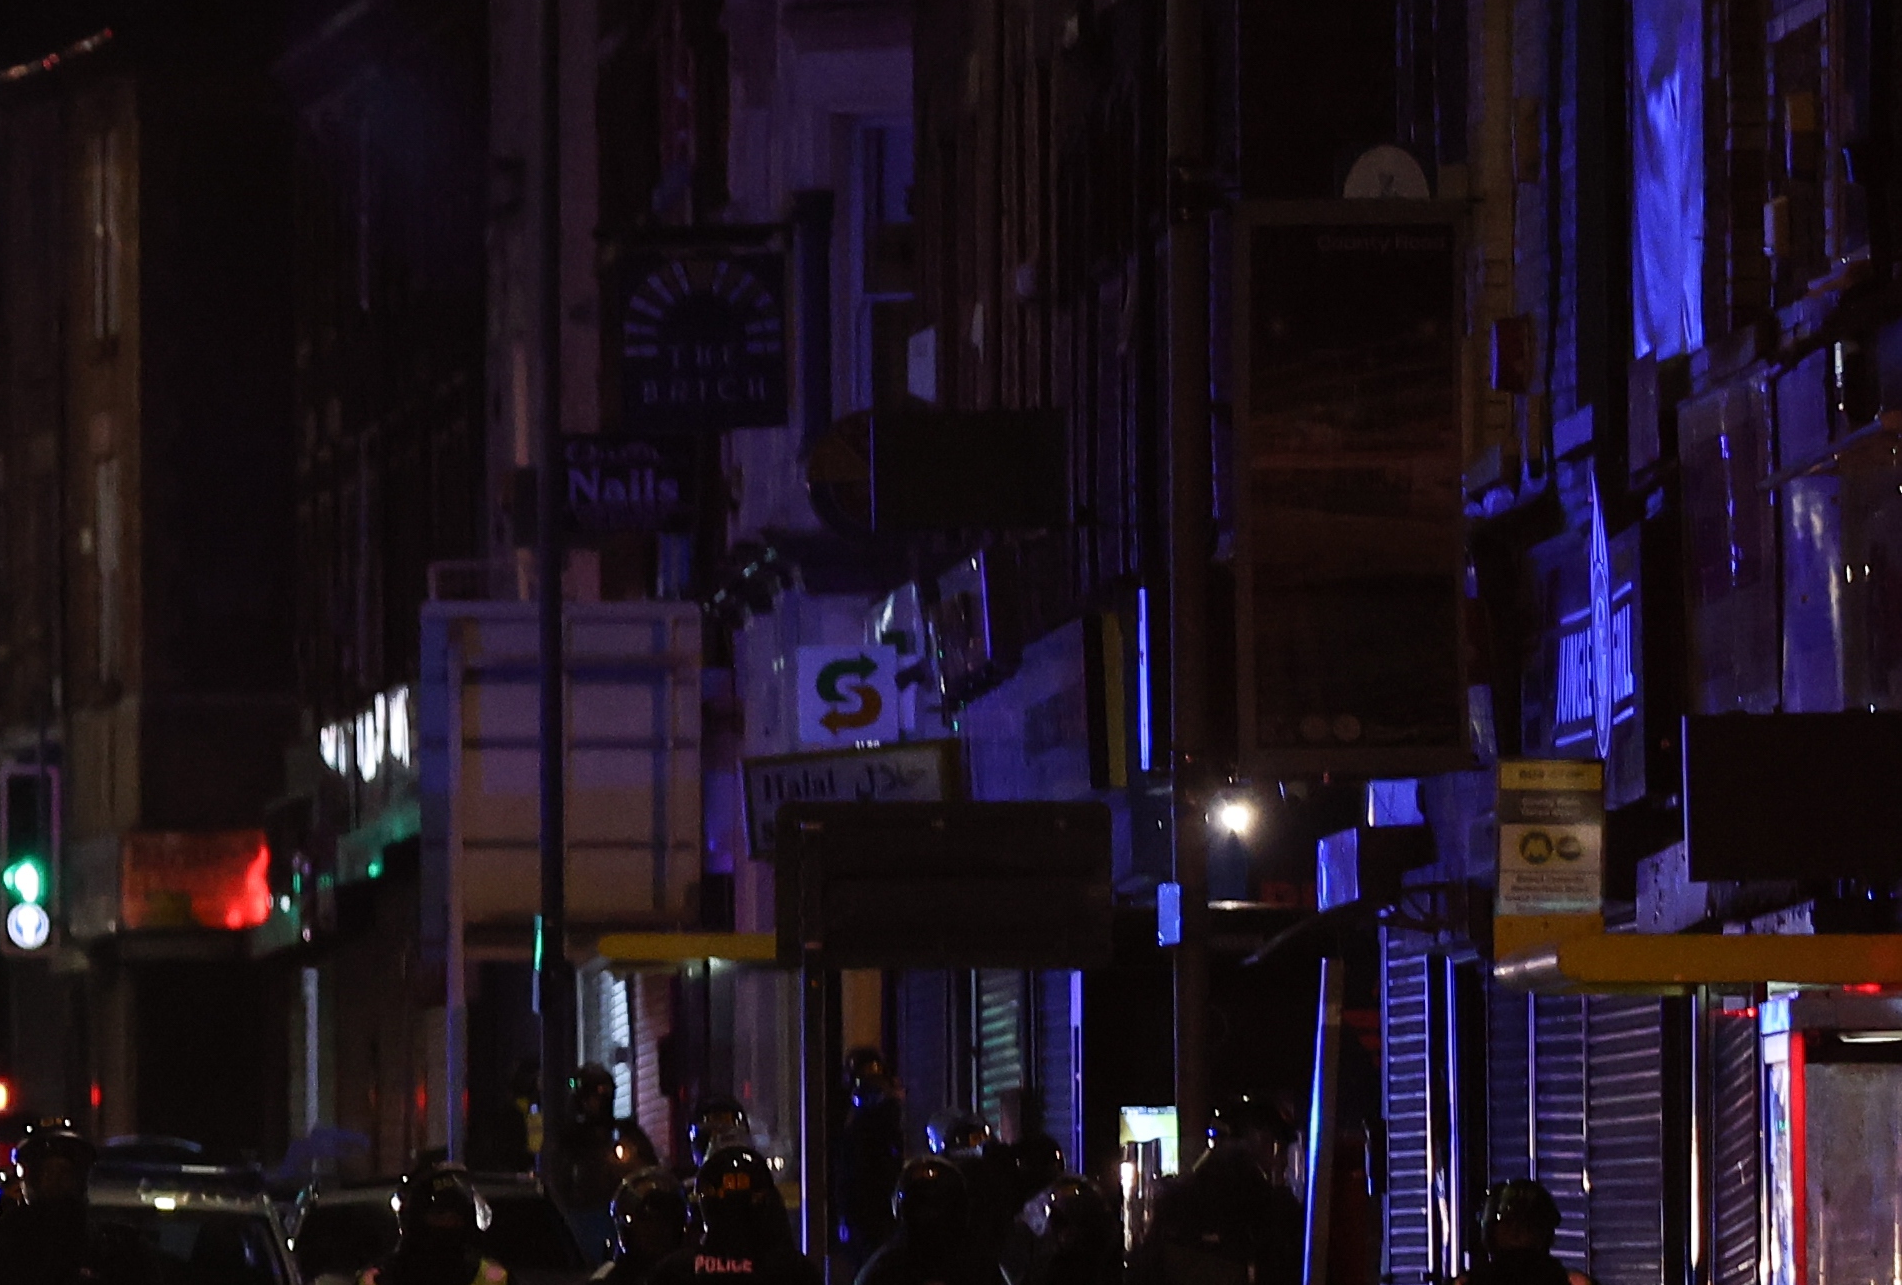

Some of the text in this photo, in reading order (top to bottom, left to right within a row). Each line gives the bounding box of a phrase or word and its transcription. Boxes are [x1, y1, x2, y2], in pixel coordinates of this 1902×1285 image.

[567, 467, 680, 503] Nails
[1555, 626, 1593, 727] JUNGLE
[764, 768, 836, 801] Halal
[694, 1254, 754, 1274] POLICE
